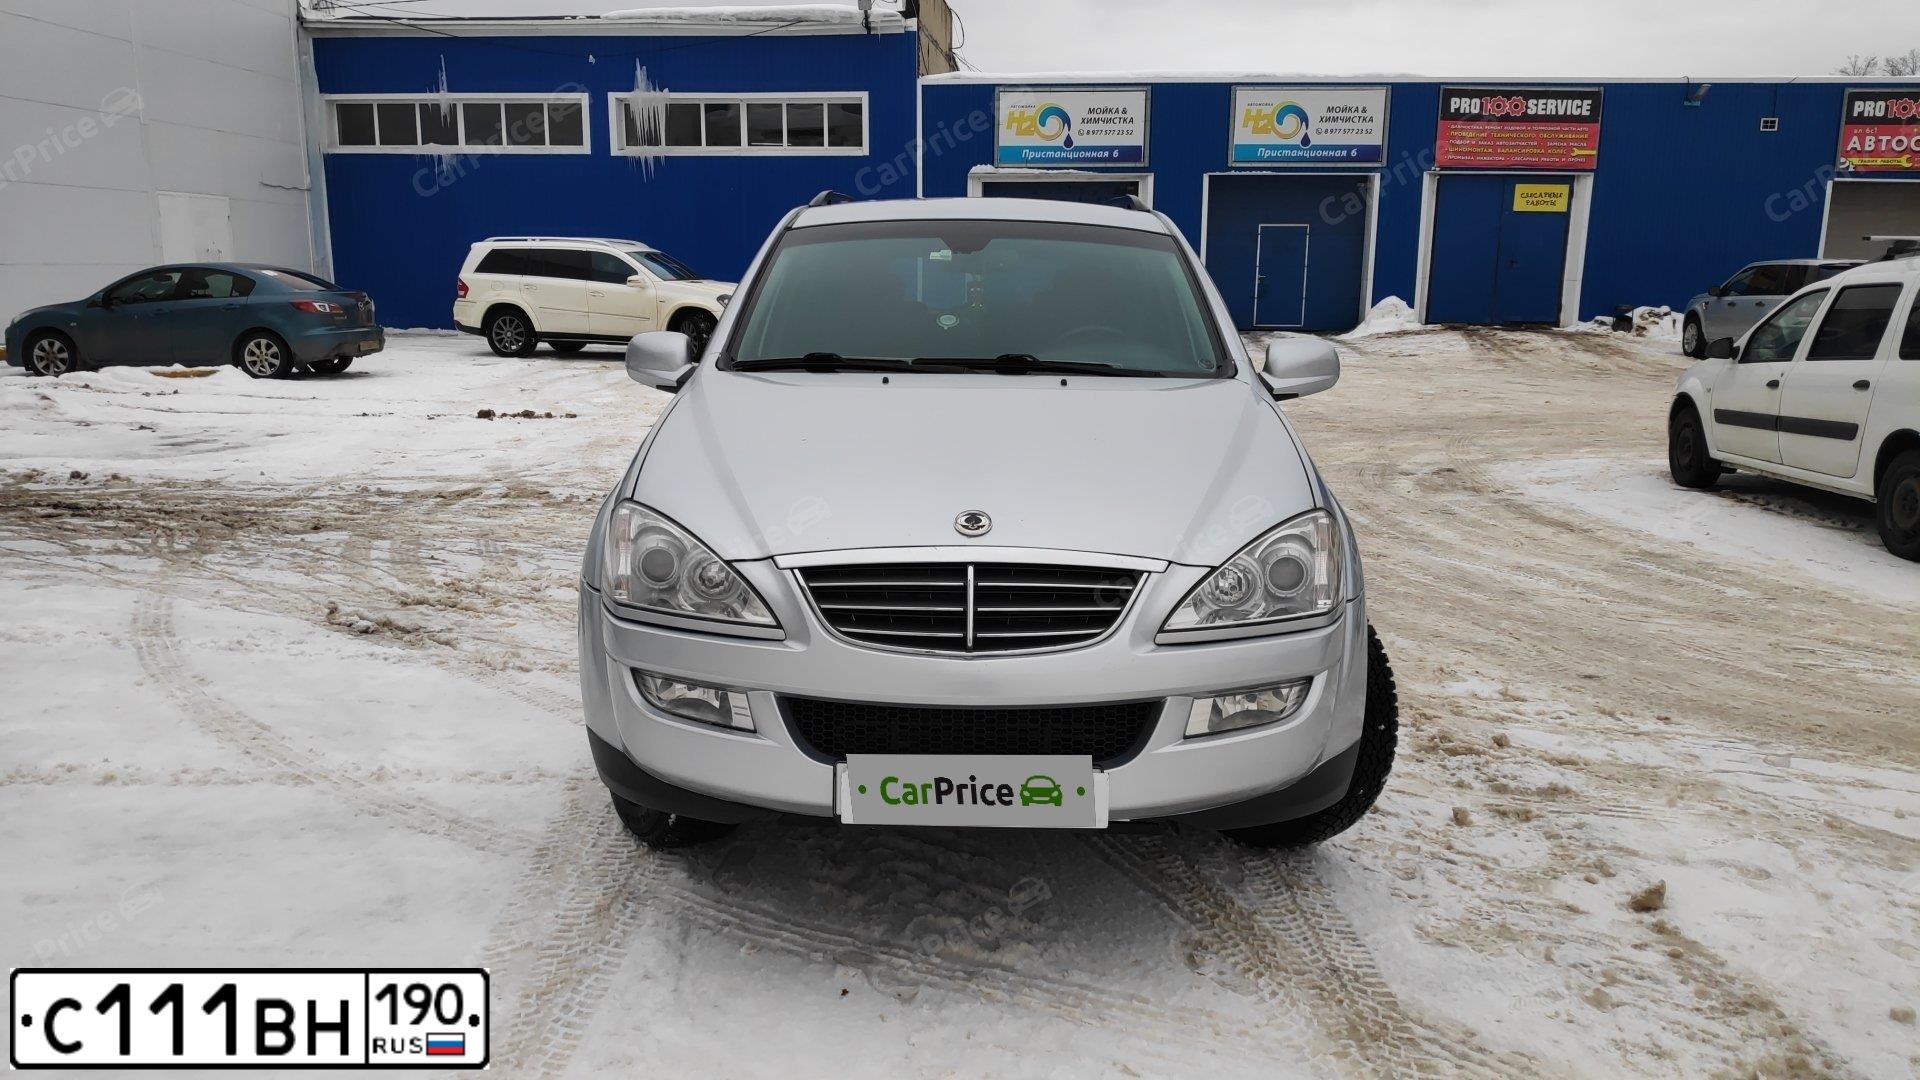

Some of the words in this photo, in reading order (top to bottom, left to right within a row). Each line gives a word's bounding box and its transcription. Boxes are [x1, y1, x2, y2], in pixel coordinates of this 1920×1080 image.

[1087, 106, 1120, 115] МОЙКА
[1121, 107, 1128, 115] &
[1326, 105, 1359, 114] МОЙКА
[1360, 106, 1368, 114] &
[1080, 117, 1134, 125] ХИМЧИСТКА
[1318, 115, 1374, 124] ХИМЧИСТКА
[1022, 149, 1109, 160] Пристанционная
[1112, 149, 1119, 158] 6
[1257, 148, 1347, 159] Пристанционная
[1350, 148, 1357, 157] 6
[1526, 199, 1556, 207] РАБОТЫ
